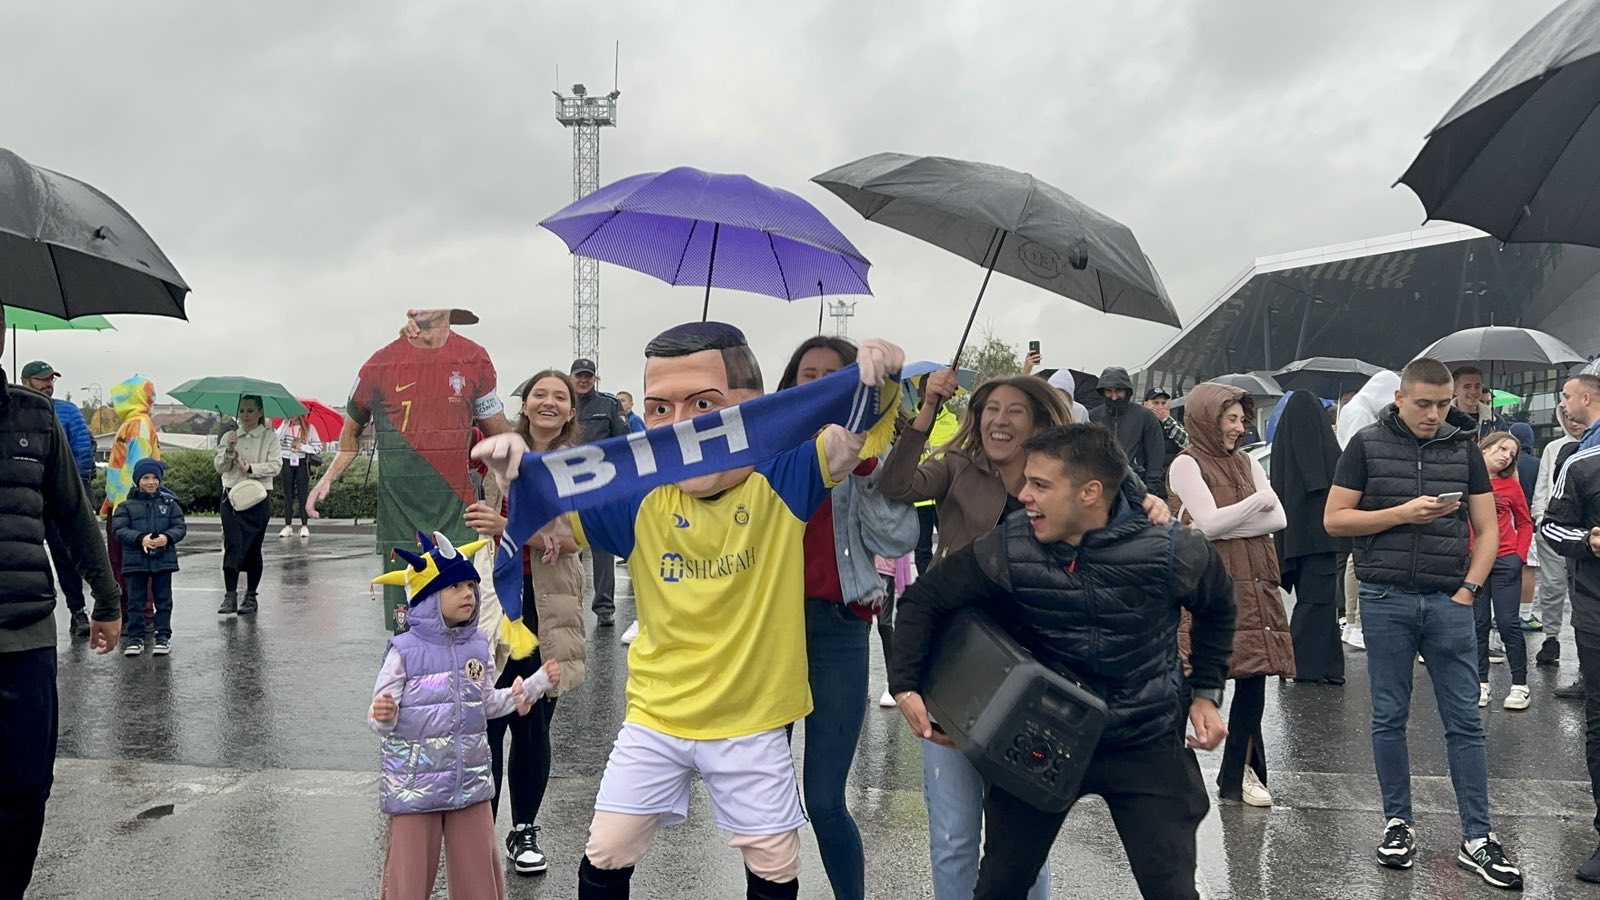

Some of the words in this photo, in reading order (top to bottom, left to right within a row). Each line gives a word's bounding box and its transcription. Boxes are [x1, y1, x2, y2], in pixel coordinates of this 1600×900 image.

[401, 400, 412, 433] 7
[541, 404, 749, 499] BIH
[685, 546, 756, 580] SHURFAH
